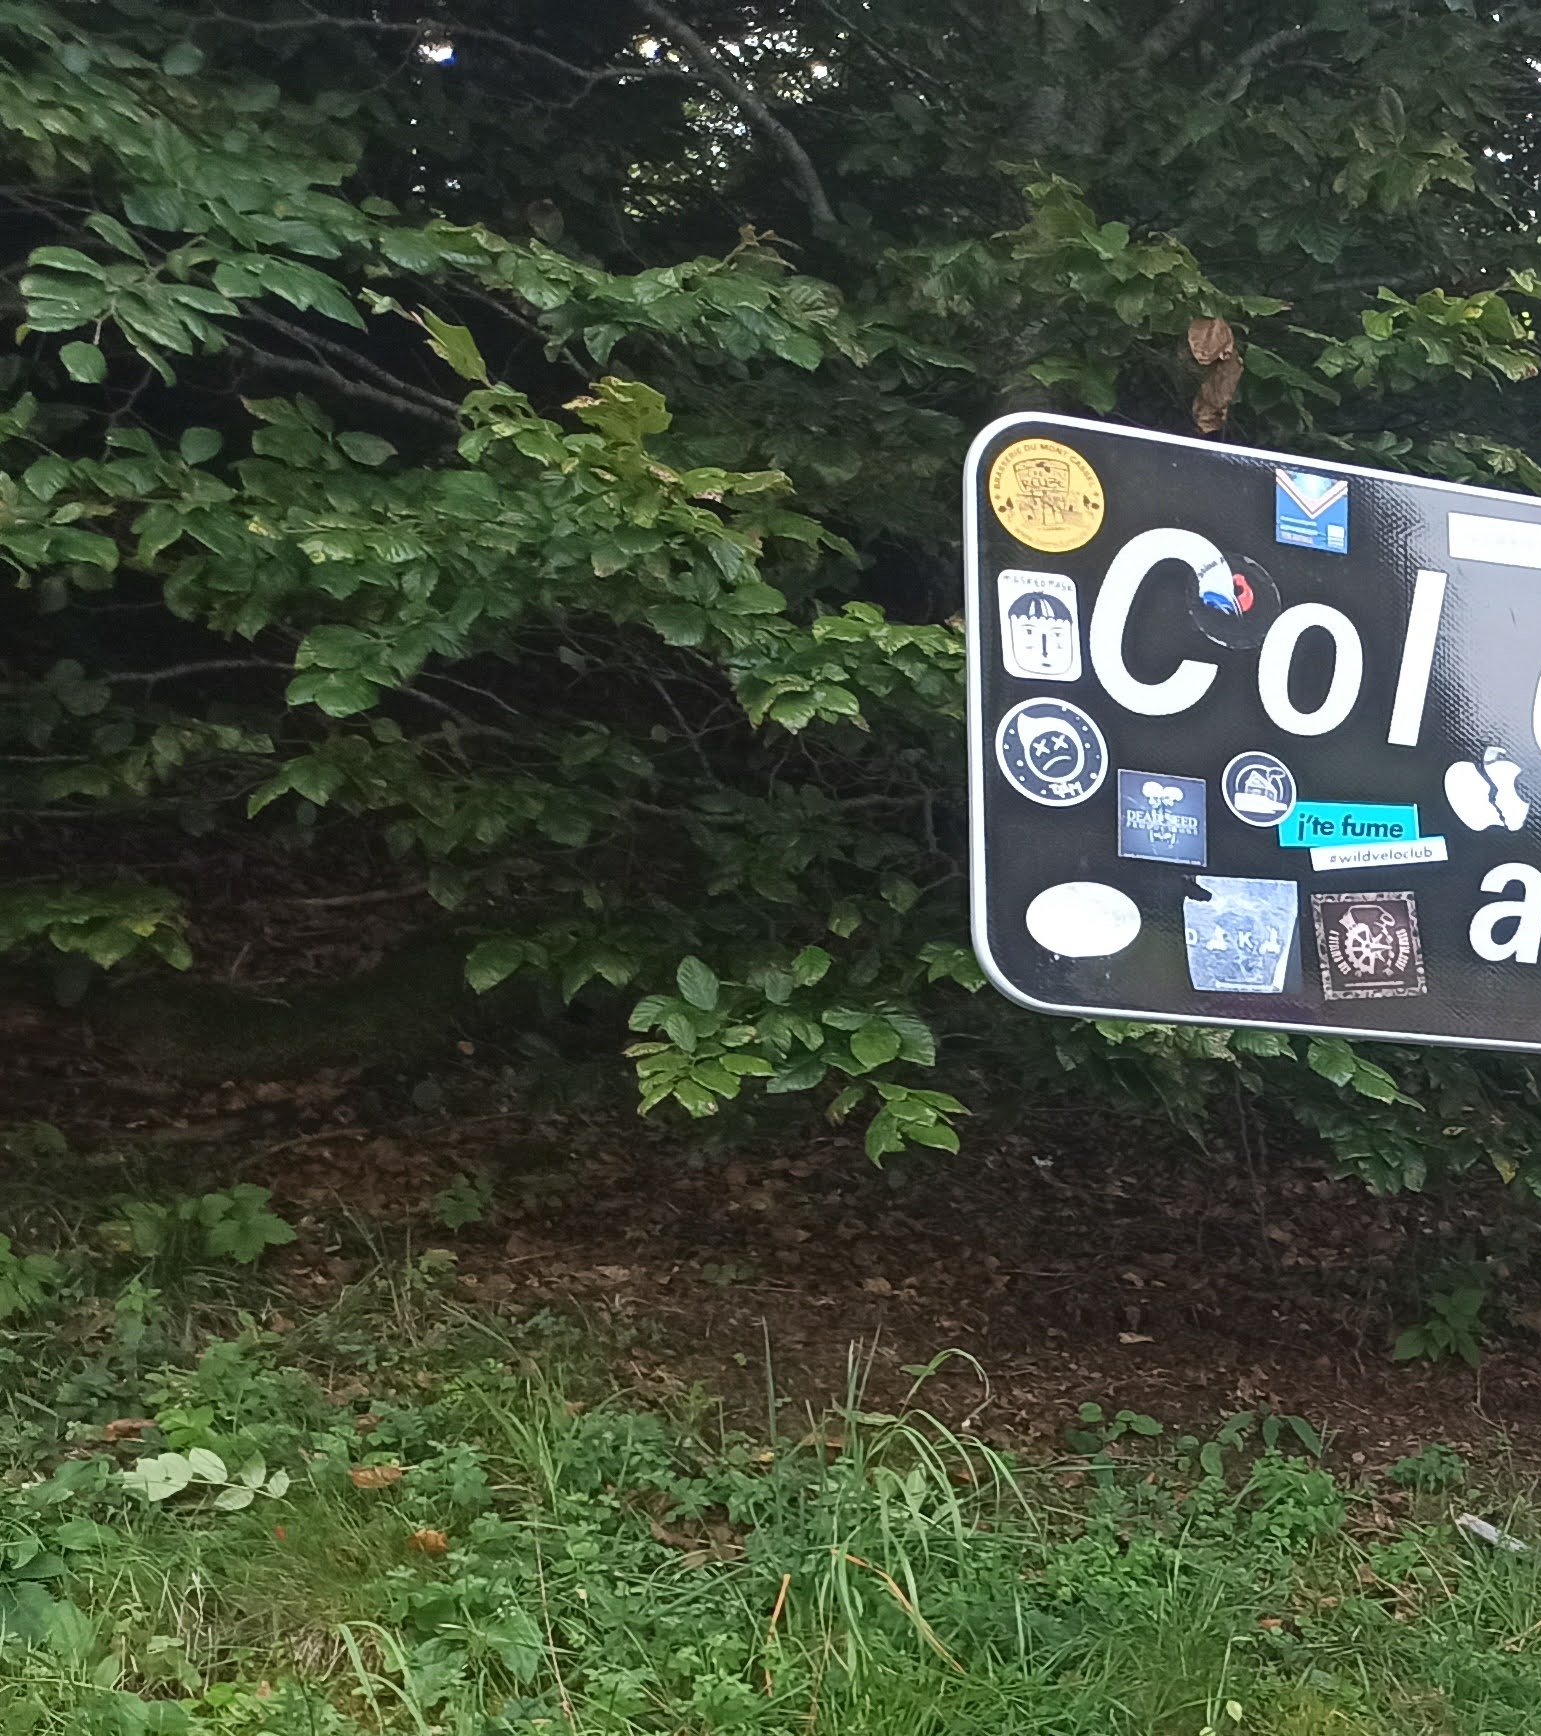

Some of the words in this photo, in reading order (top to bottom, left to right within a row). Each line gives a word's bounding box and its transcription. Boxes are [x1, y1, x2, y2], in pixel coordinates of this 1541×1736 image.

[1023, 443, 1038, 452] DU
[1089, 527, 1448, 747] Col
[1341, 813, 1404, 839] fume
[1329, 846, 1433, 864] #wildveloclub
